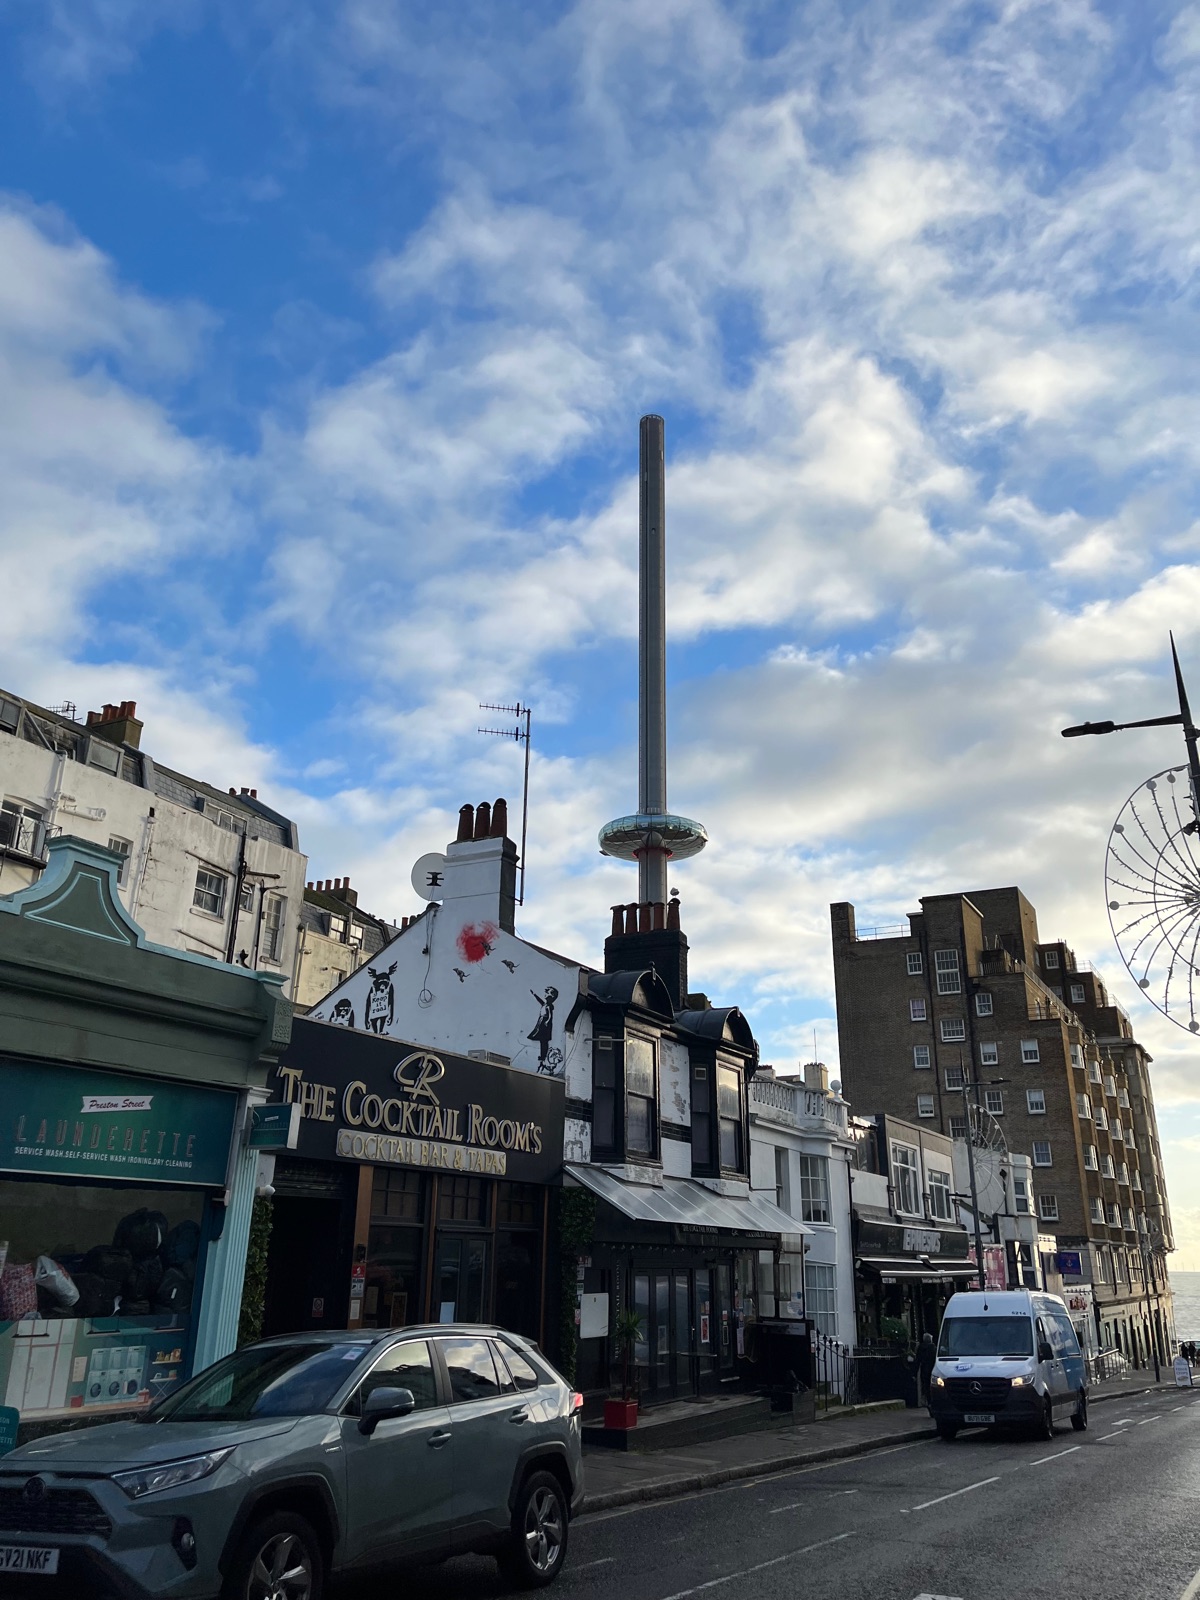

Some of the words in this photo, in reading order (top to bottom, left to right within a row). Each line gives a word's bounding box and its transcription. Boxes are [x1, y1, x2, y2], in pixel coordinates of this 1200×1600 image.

[89, 1099, 119, 1110] Preston
[121, 1098, 146, 1109] Street
[276, 1065, 337, 1122] THE
[342, 1080, 463, 1142] COCKTAIL
[16, 1114, 196, 1158] LAUNDERETTE
[14, 1146, 44, 1156] SERVICE
[110, 1154, 126, 1163] WASH
[165, 1159, 193, 1168] CLEANING
[338, 1132, 418, 1165] COCKTAIL
[420, 1143, 449, 1169] BAR
[453, 1150, 462, 1169] &
[467, 1149, 507, 1174] TAPAS
[26, 1549, 52, 1569] NKF
